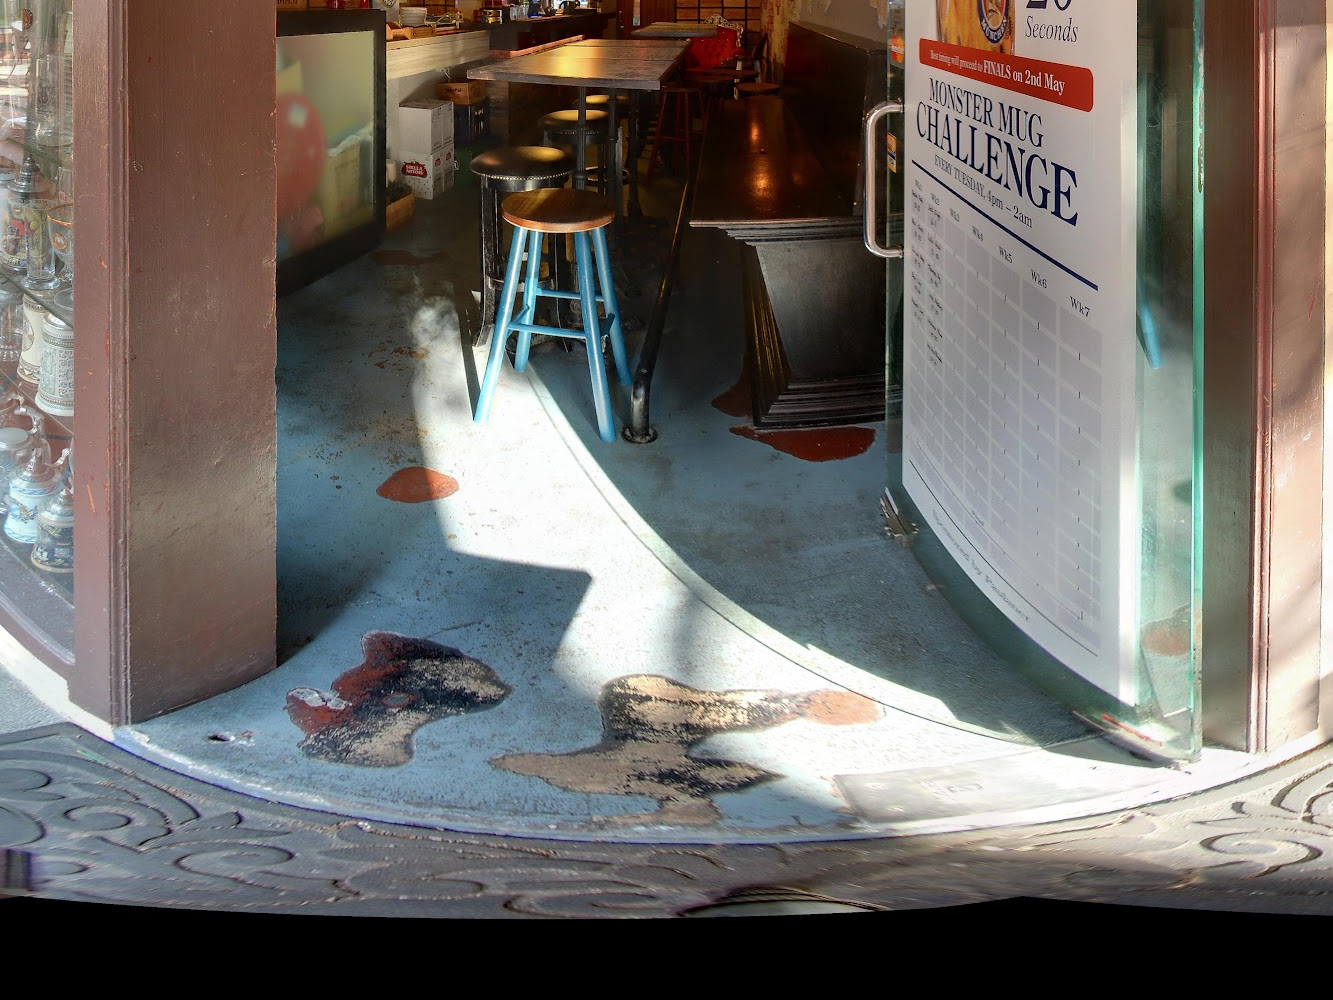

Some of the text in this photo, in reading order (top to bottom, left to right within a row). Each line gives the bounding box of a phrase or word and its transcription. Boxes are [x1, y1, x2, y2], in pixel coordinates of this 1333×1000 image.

[1025, 15, 1078, 42] Seconds
[930, 50, 939, 60] Best
[951, 55, 960, 66] will
[959, 58, 977, 71] proceed
[977, 62, 983, 72] to
[983, 60, 1011, 79] FINALS
[1013, 72, 1023, 82] on
[1025, 70, 1042, 87] 2nd
[1044, 73, 1065, 95] May
[929, 77, 1044, 148] MONSTER MUG
[916, 101, 1078, 227] CHALLENGE
[934, 154, 953, 177] EVERY
[953, 166, 986, 199] TUESDAY,
[986, 188, 1004, 211] 4pm
[1013, 205, 1032, 229] 2am
[998, 245, 1013, 263] Wk5
[1030, 269, 1048, 289] Wk6
[1070, 296, 1090, 317] Wk7
